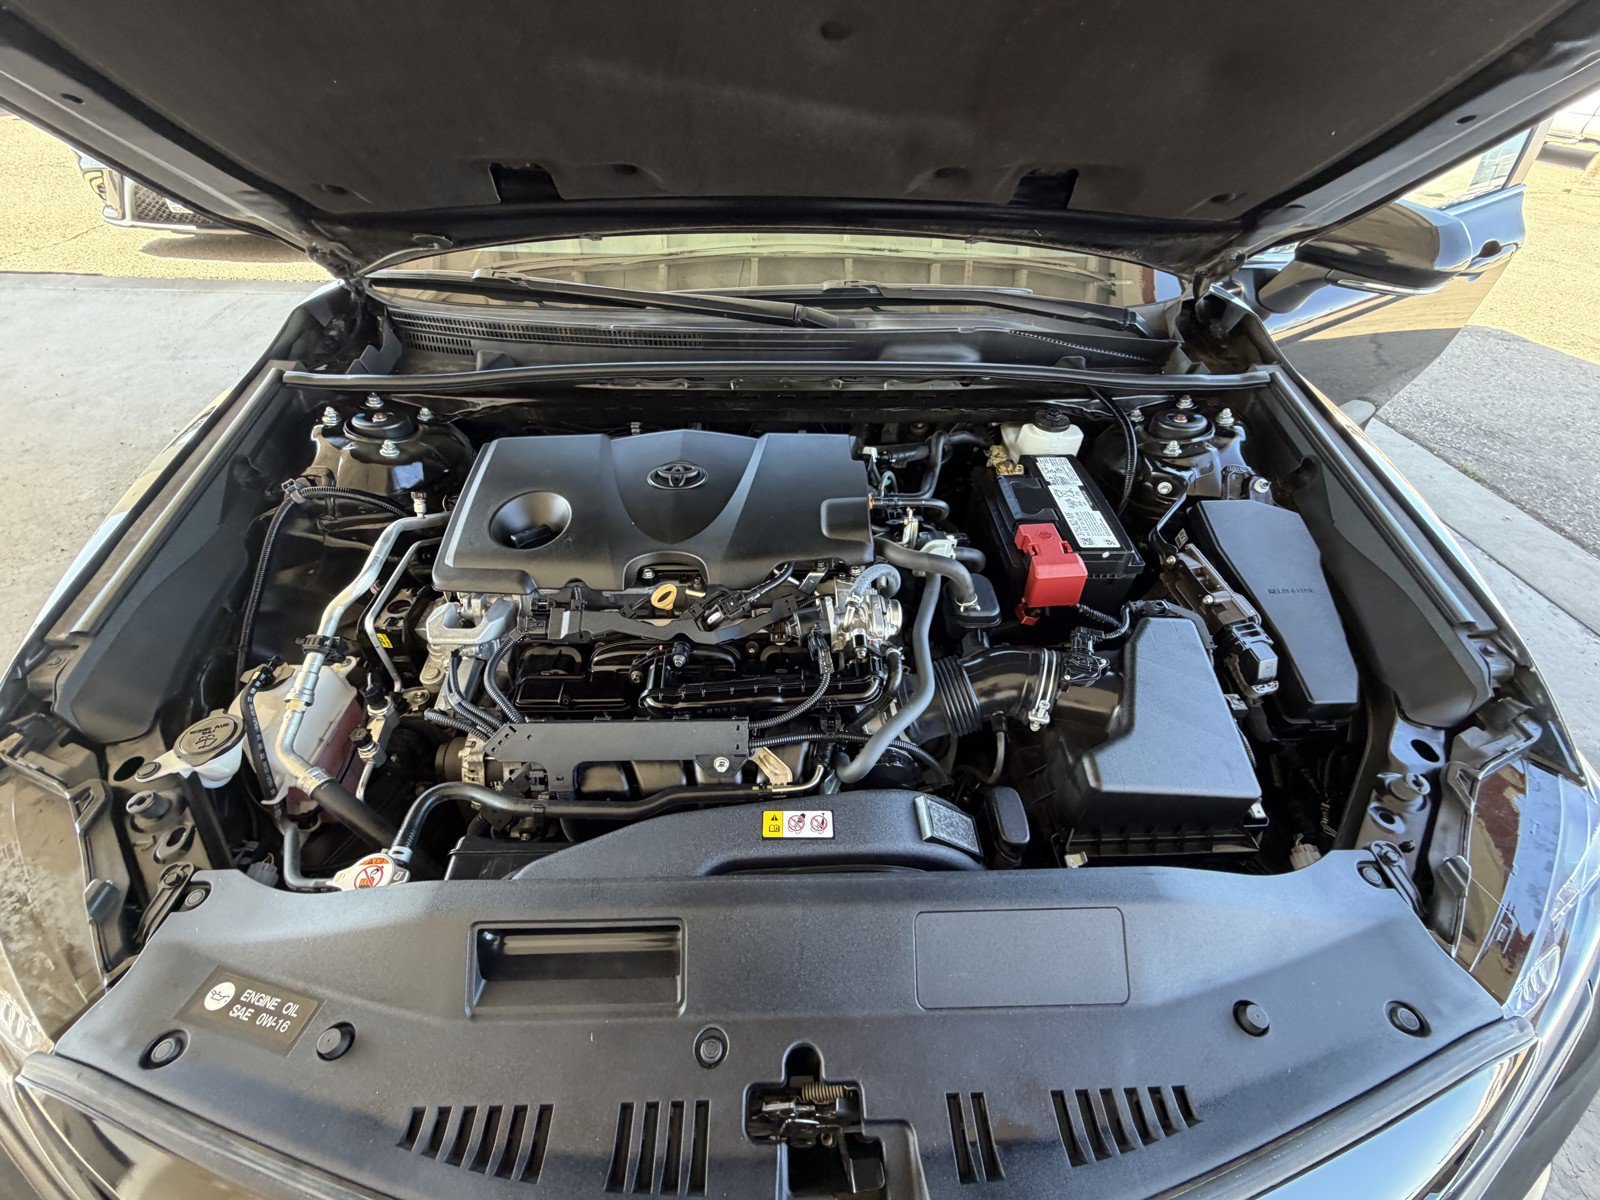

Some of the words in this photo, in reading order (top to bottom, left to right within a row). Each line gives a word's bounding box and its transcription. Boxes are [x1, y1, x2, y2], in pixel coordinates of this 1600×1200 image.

[240, 989, 281, 1011] ENGINE
[283, 1001, 300, 1017] OIL
[229, 1004, 254, 1021] SAE
[256, 1013, 290, 1033] 0W-16
